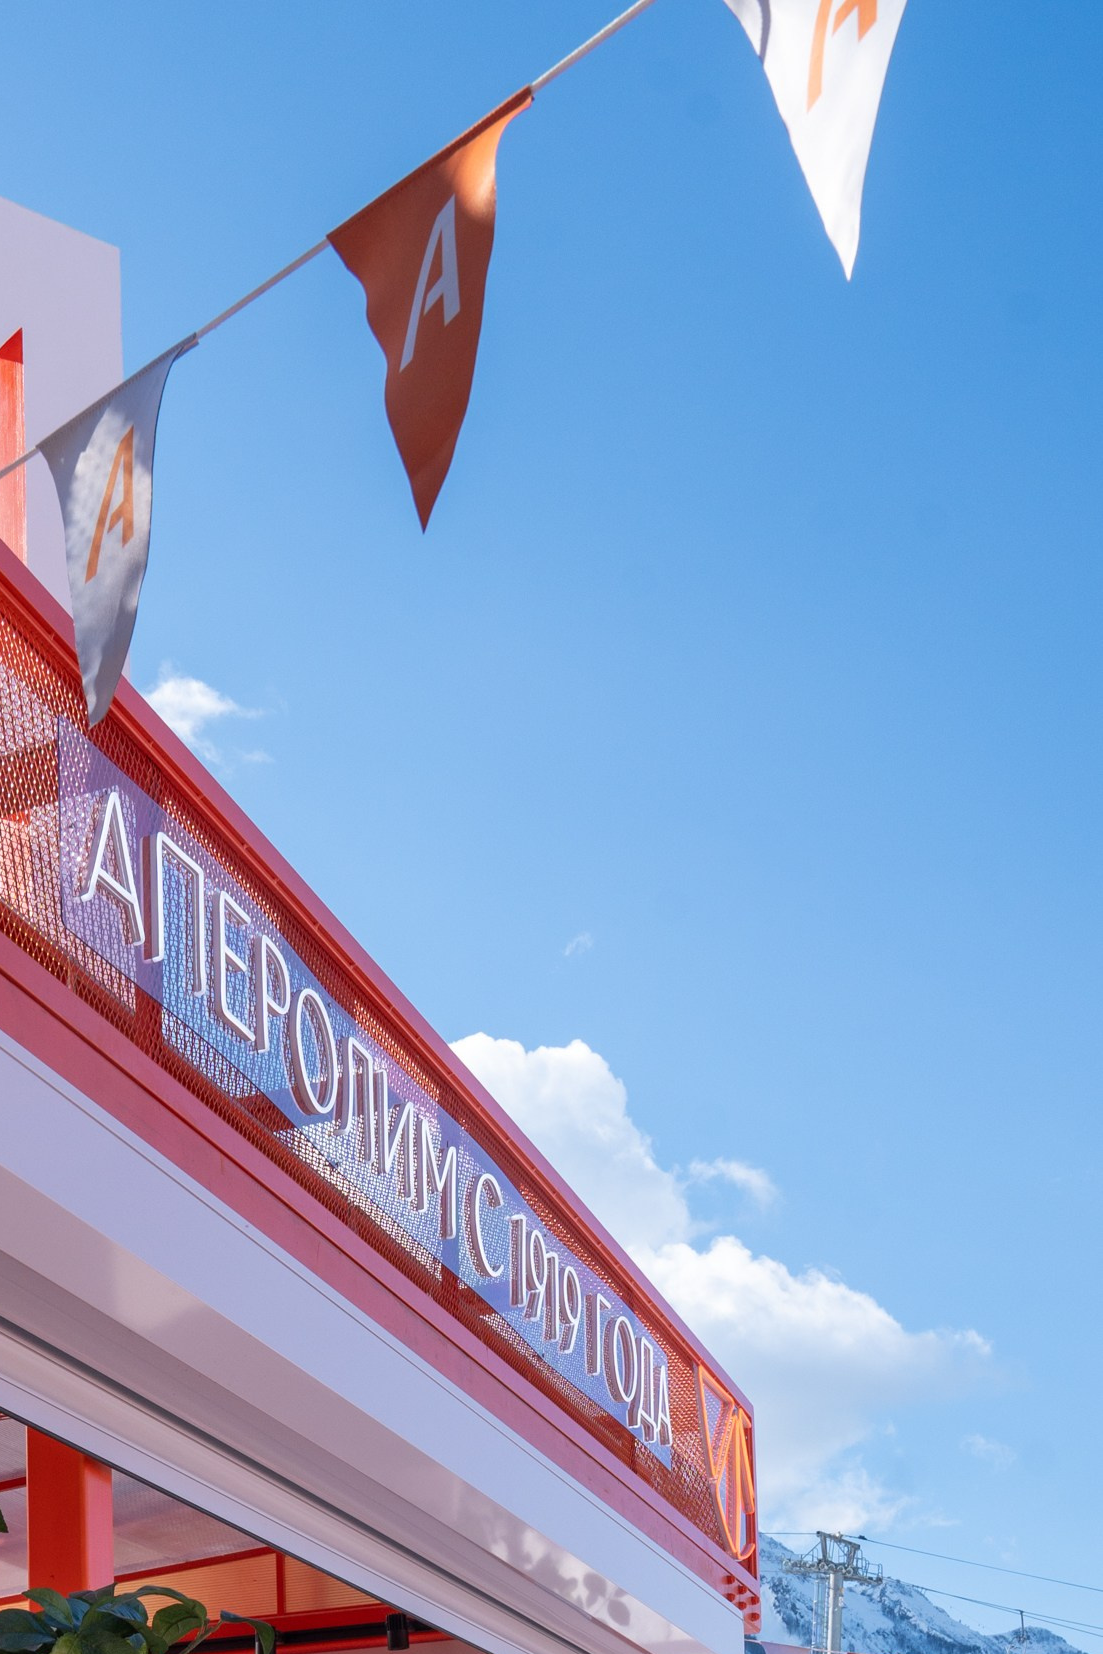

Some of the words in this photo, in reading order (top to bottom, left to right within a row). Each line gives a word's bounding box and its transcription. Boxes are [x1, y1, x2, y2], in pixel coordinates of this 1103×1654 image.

[399, 193, 460, 373] A
[84, 425, 135, 584] A
[79, 791, 459, 1241] АПЕРОЛИМ
[465, 1173, 505, 1279] С
[509, 1213, 582, 1355] 1919
[586, 1292, 673, 1448] ГОДА
